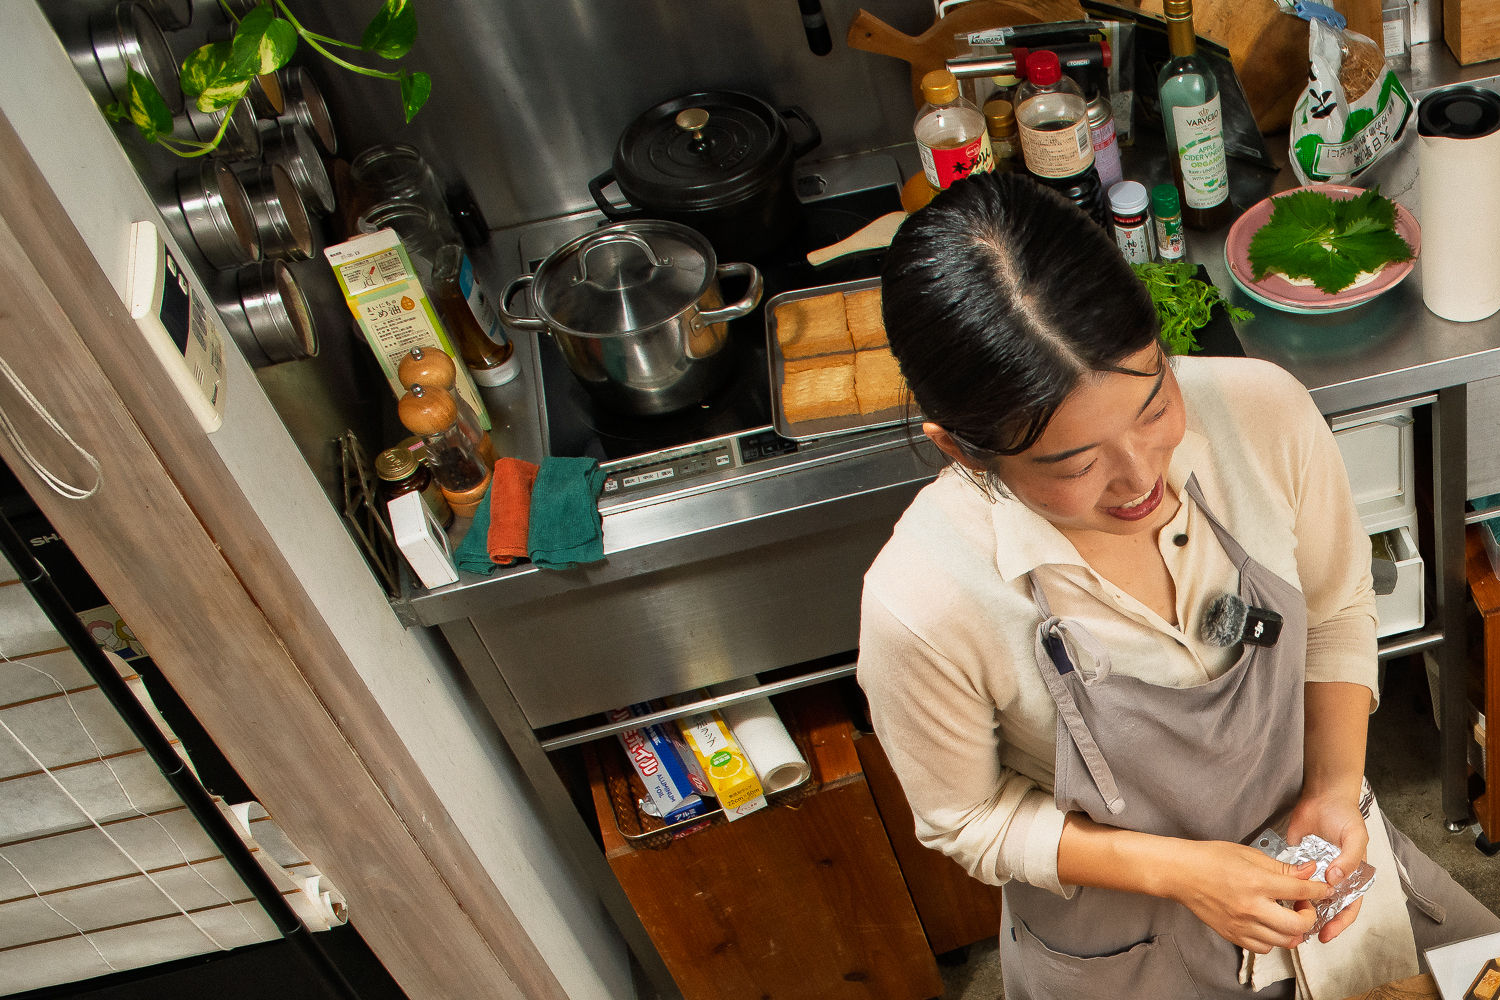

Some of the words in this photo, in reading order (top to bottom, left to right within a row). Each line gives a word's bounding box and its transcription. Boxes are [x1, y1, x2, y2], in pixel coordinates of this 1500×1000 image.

[1198, 142, 1216, 154] APPLE
[1183, 151, 1205, 161] CIDER
[370, 304, 402, 322] こめ油
[30, 533, 62, 547] SH
[654, 785, 665, 800] FOIL
[656, 773, 676, 804] ALUMINUM
